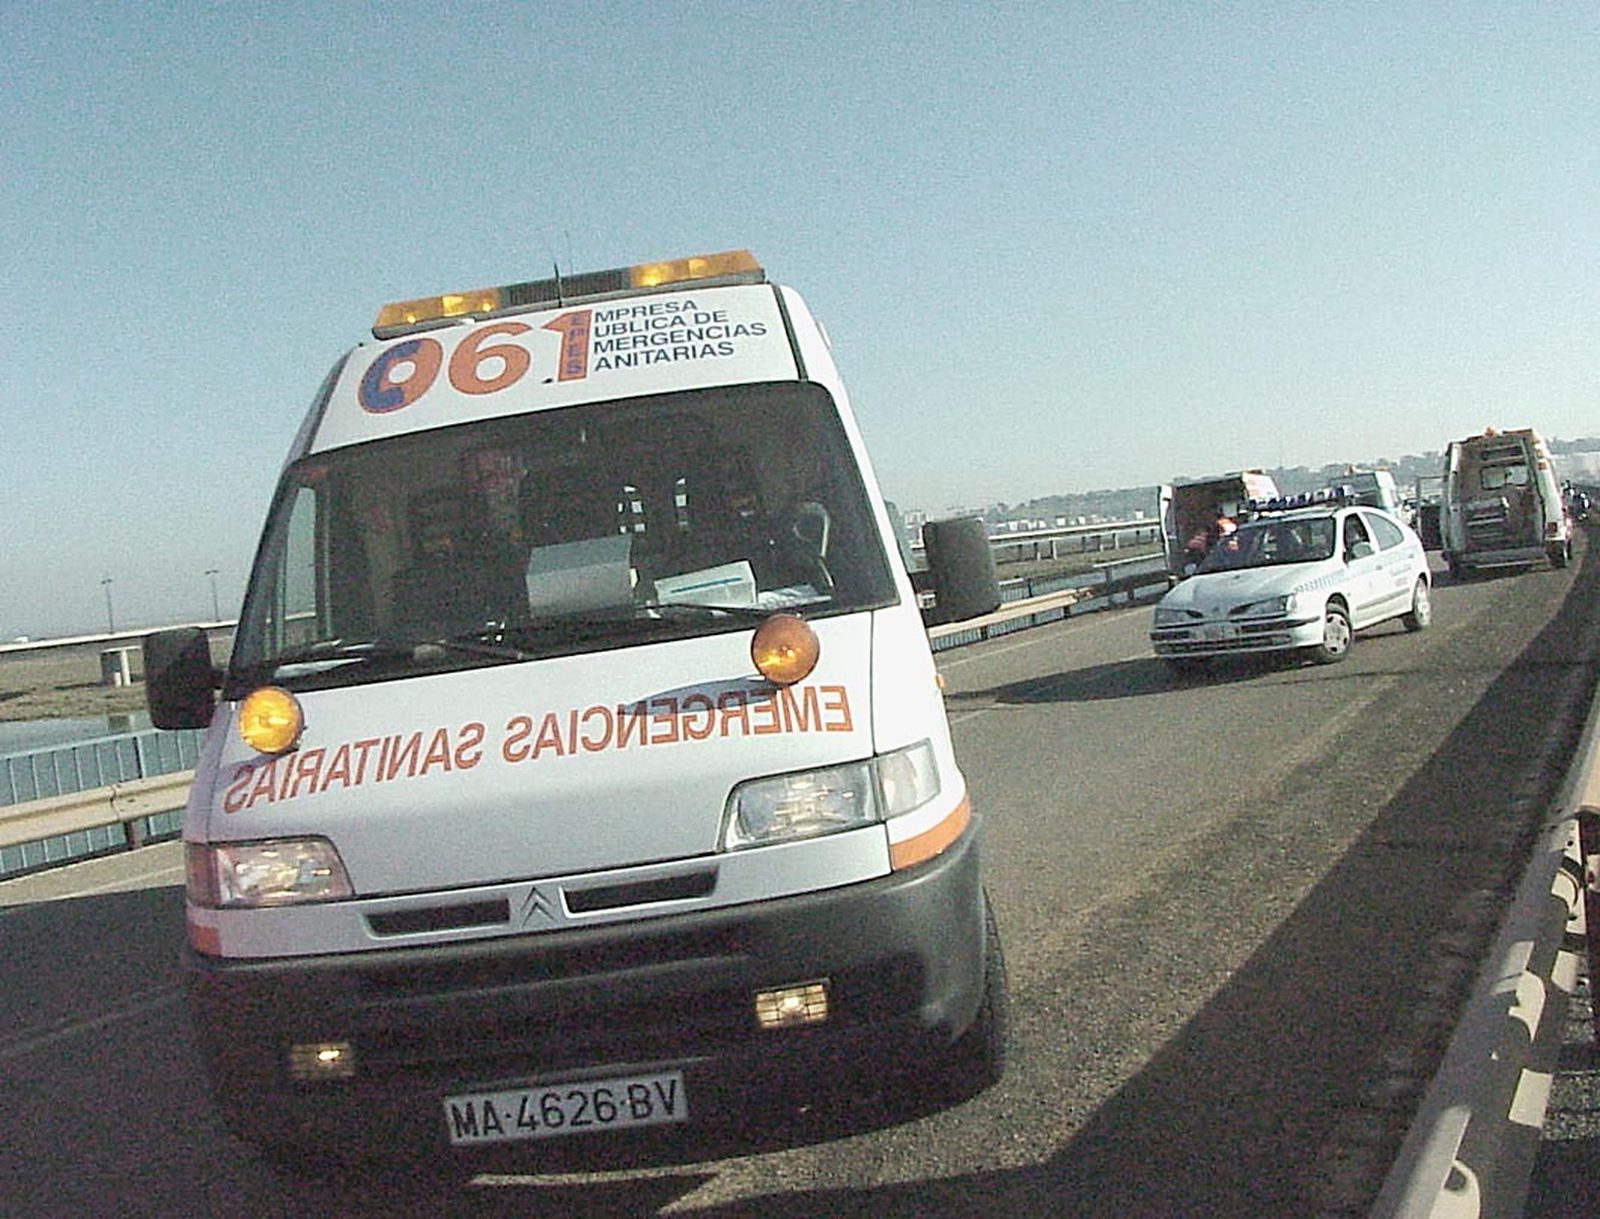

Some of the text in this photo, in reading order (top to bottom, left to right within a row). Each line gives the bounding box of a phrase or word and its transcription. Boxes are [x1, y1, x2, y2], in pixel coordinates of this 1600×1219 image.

[594, 300, 698, 323] MPRESA
[594, 309, 729, 338] UBLICA DE
[593, 322, 768, 354] MERGENCIAS
[358, 308, 592, 414] 061
[594, 341, 735, 372] ANITARIAS
